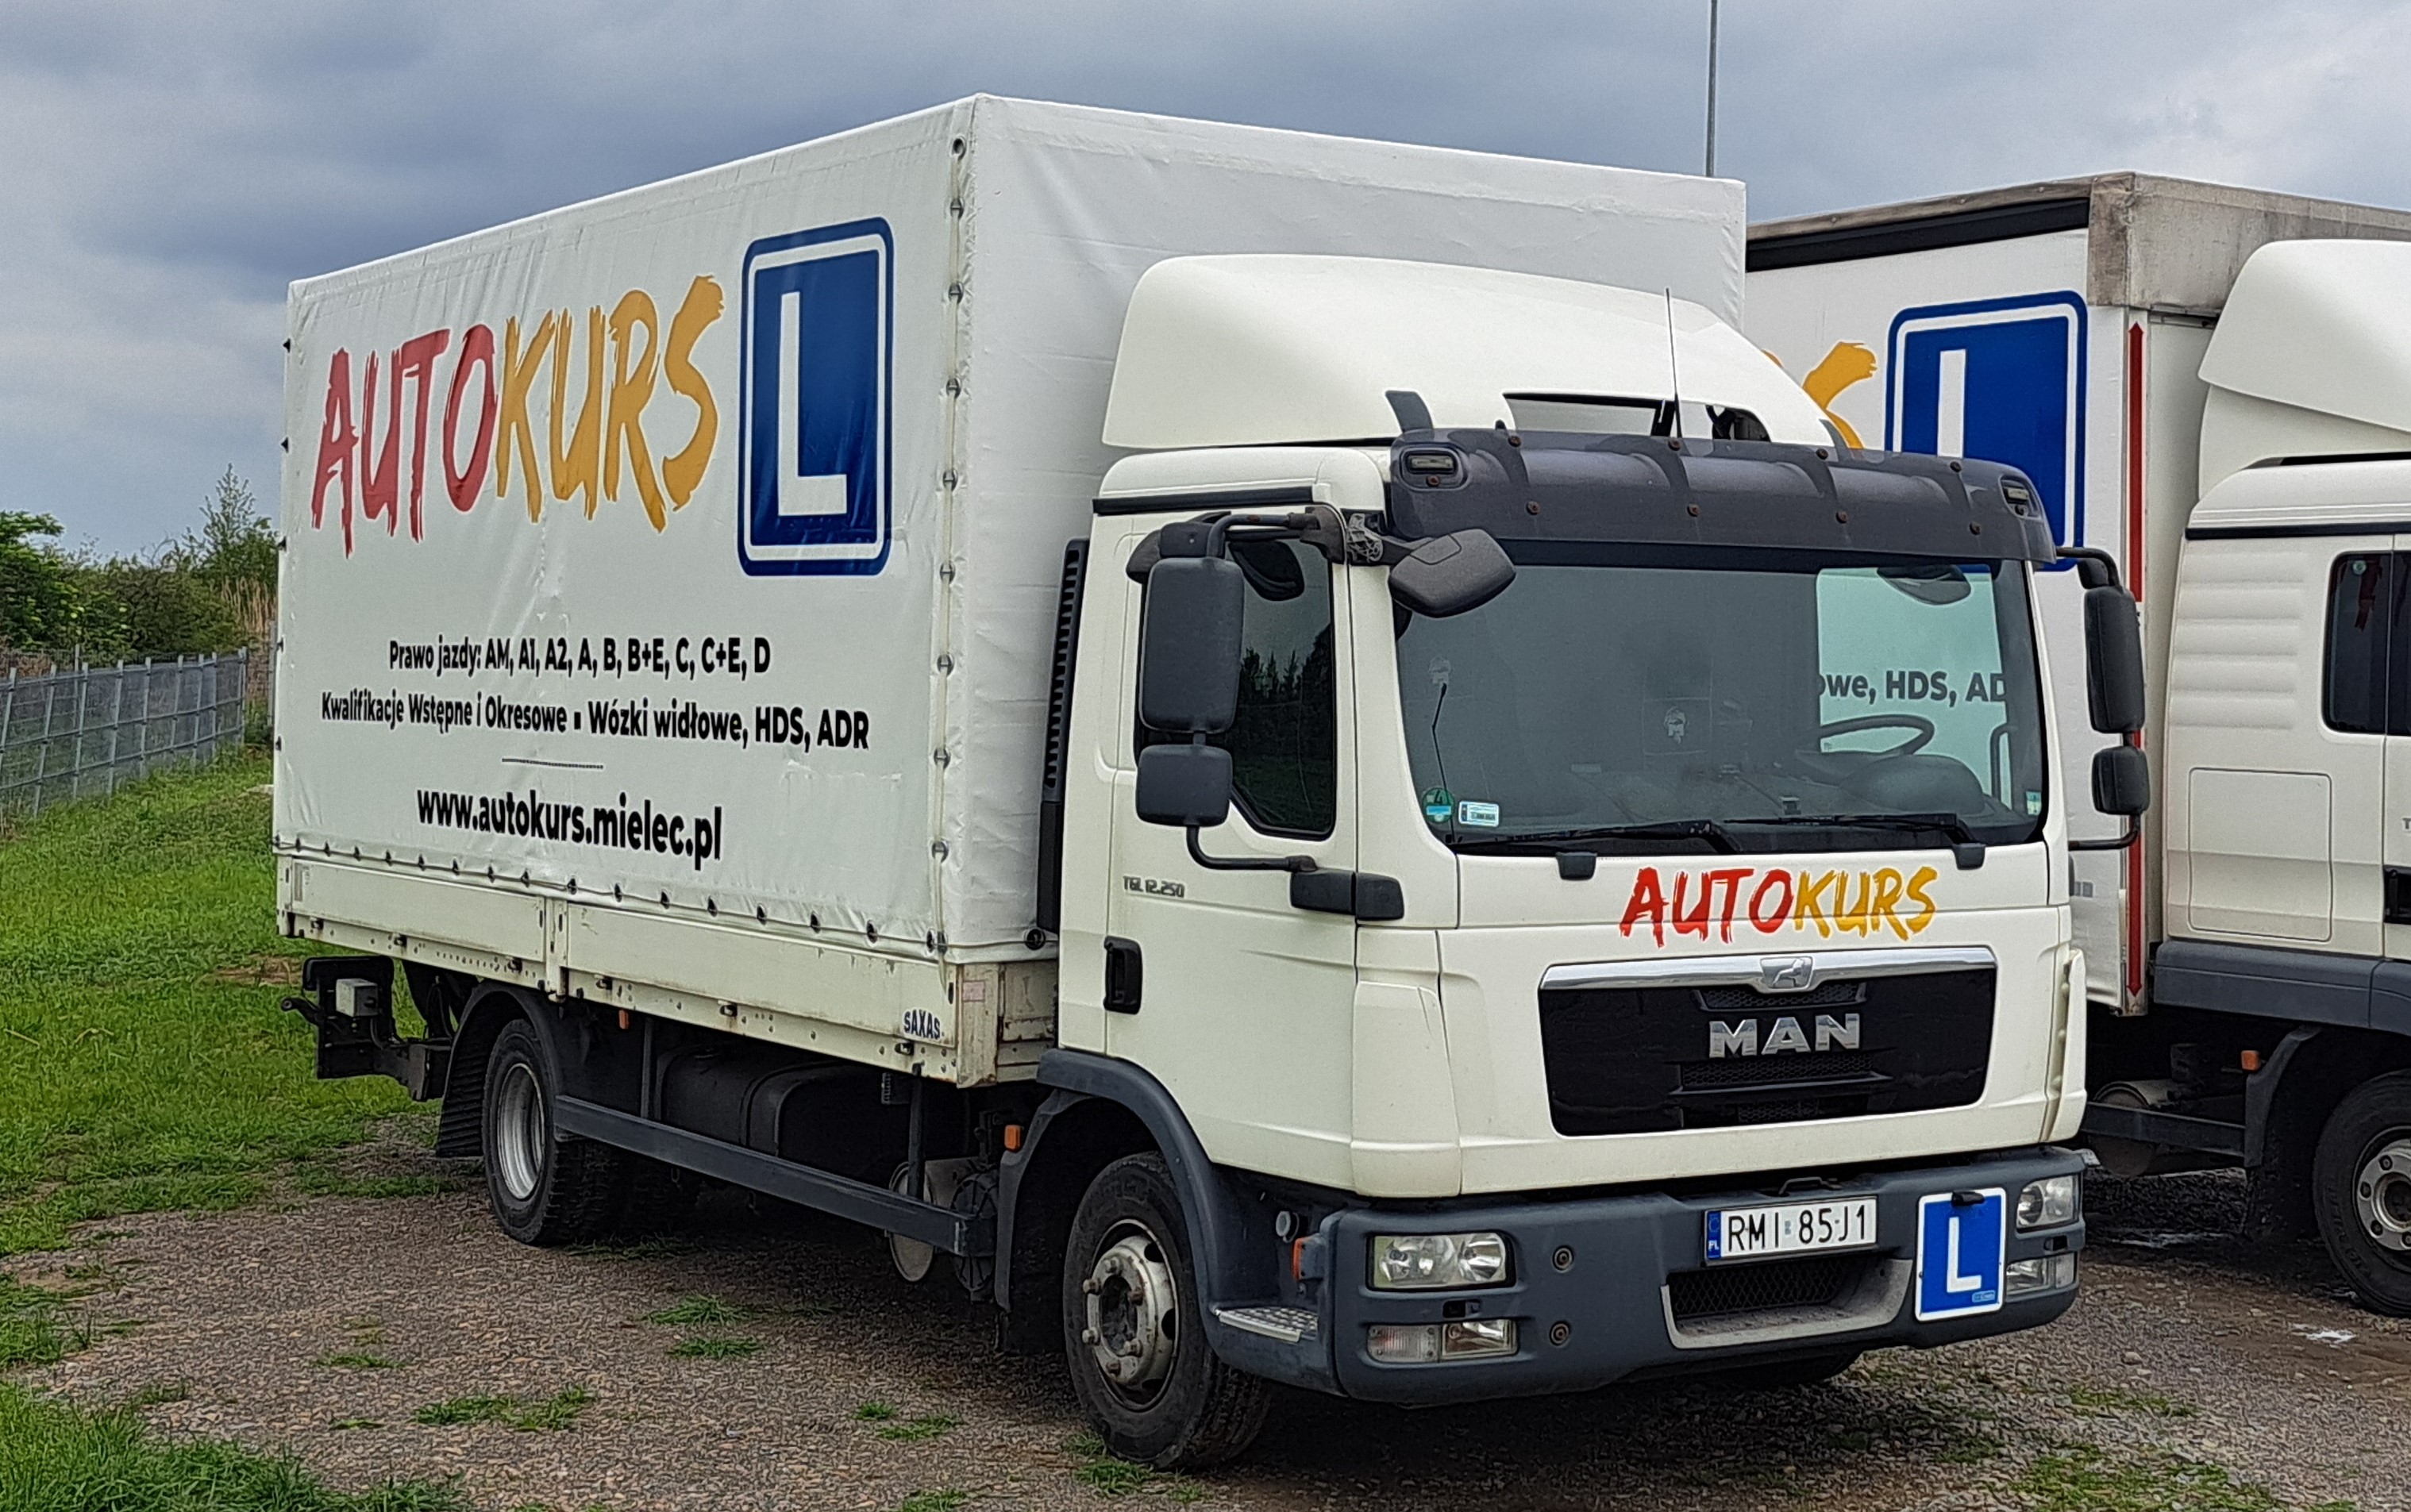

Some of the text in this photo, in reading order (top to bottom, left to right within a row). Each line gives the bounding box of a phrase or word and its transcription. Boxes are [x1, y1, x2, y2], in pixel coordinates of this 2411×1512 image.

[311, 275, 725, 559] AUTOKURS
[778, 291, 847, 515] L
[390, 634, 771, 681] Prawo jazdy: AM, A1, A2, A, B, B+E, C, C+E, D
[1886, 670, 1956, 707] HDS,
[322, 688, 869, 753] Kwalifikacje Wstępne i Okresowe Wózki widłowe, HDS, ADR
[417, 790, 722, 871] www.autokurs.mielec.pl
[1619, 866, 1938, 948] AUTOKURS
[903, 1009, 940, 1040] SAXAS
[1709, 1013, 1860, 1058] MAN
[1708, 1240, 1720, 1252] PL
[1728, 1204, 1865, 1252] RMI 85J1
[1947, 1216, 1982, 1294] L
